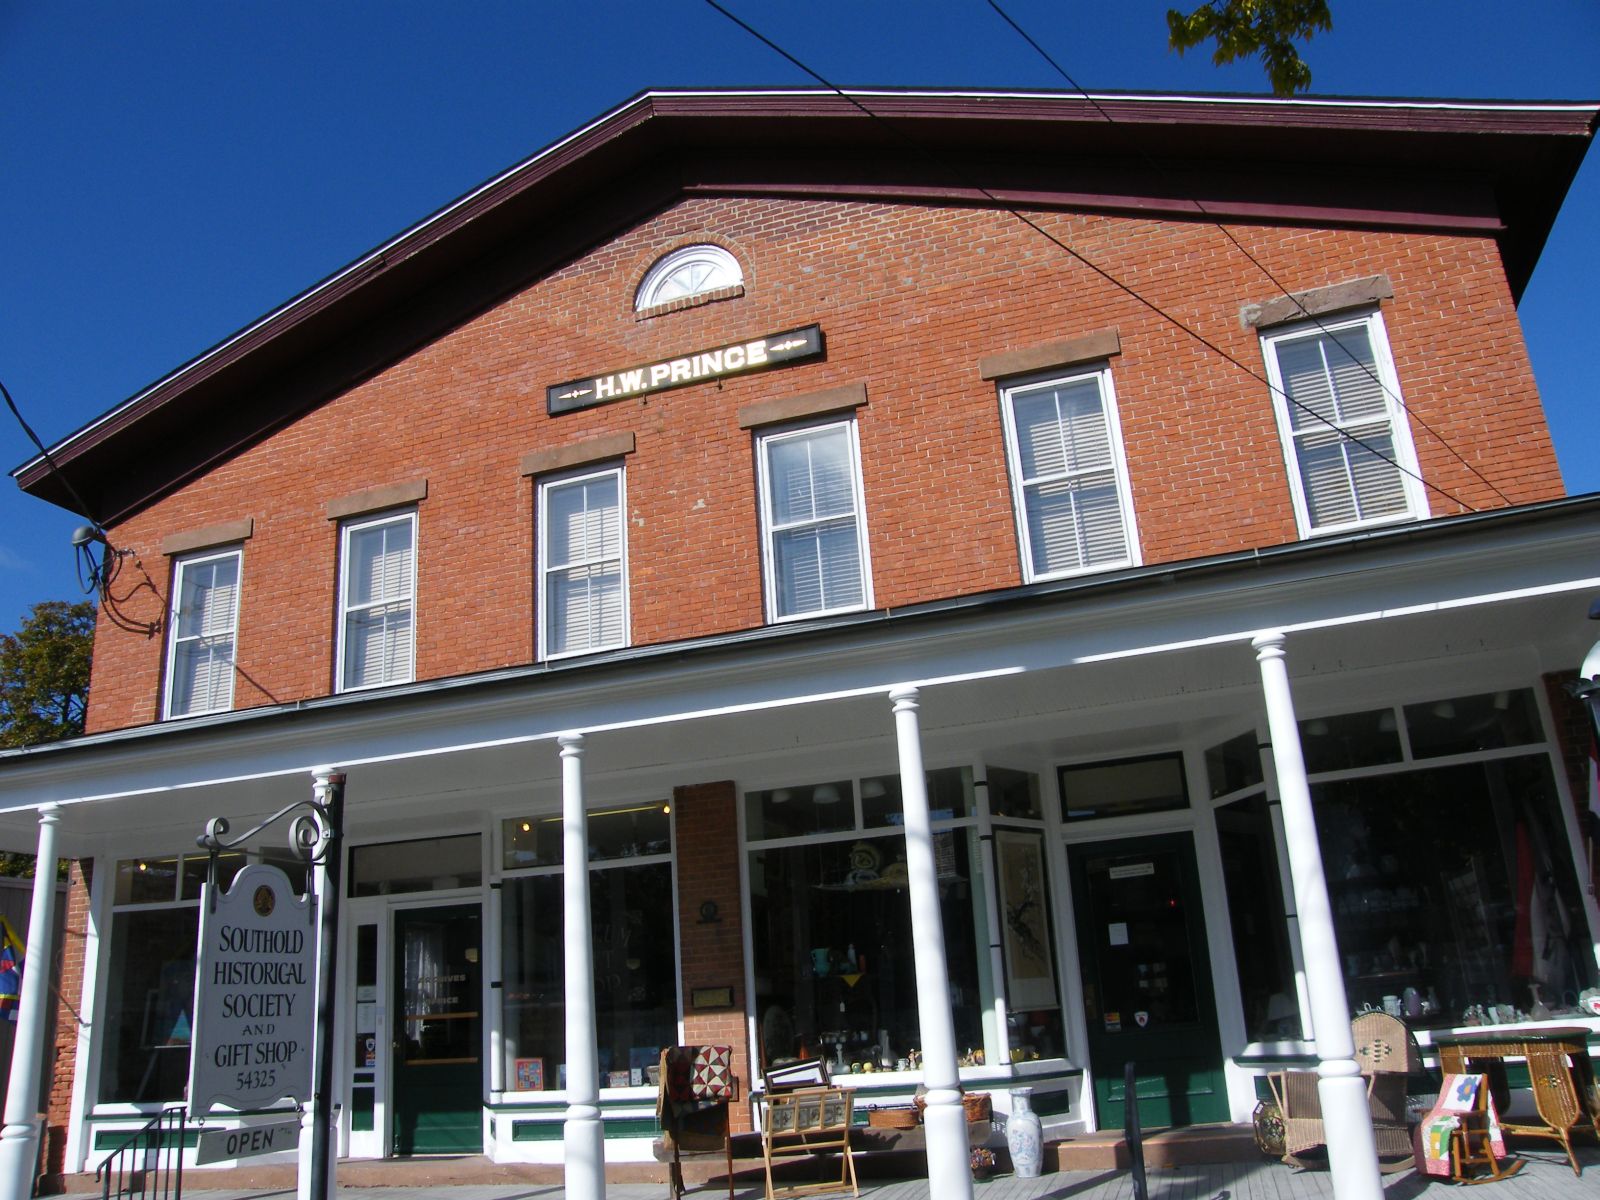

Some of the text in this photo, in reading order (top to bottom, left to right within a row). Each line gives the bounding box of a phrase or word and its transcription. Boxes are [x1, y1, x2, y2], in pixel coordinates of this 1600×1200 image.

[651, 340, 768, 387] PRINCE
[219, 925, 304, 954] SOUTHOLD
[213, 961, 307, 985] HISTORICAL
[222, 993, 296, 1018] SOCIETY
[242, 1023, 275, 1036] AND
[214, 1040, 298, 1067] GIFT SHOP
[236, 1069, 276, 1091] 54325
[227, 1128, 275, 1155] OPEN
